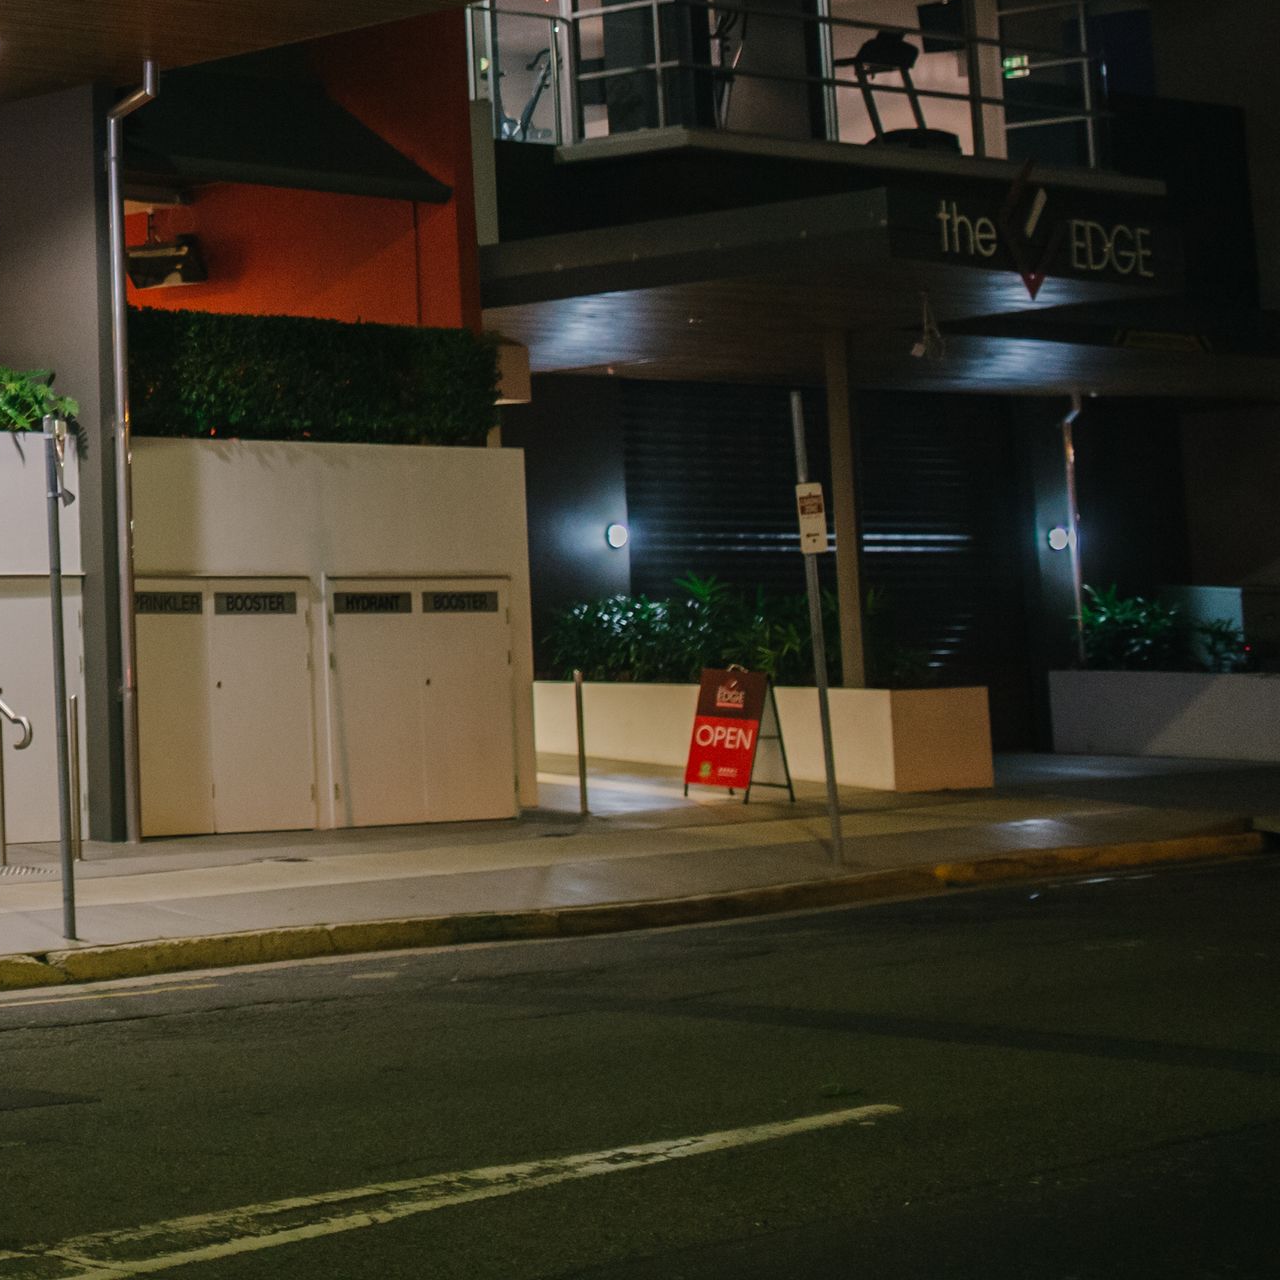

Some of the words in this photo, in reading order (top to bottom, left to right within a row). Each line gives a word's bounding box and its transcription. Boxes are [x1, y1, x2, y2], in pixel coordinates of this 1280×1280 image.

[937, 200, 997, 257] the
[1071, 218, 1155, 277] EDGE
[226, 595, 285, 612] BOOSTER
[346, 595, 400, 611] HYDRANT
[433, 594, 488, 610] BOOSTER
[695, 724, 753, 750] OPEN
